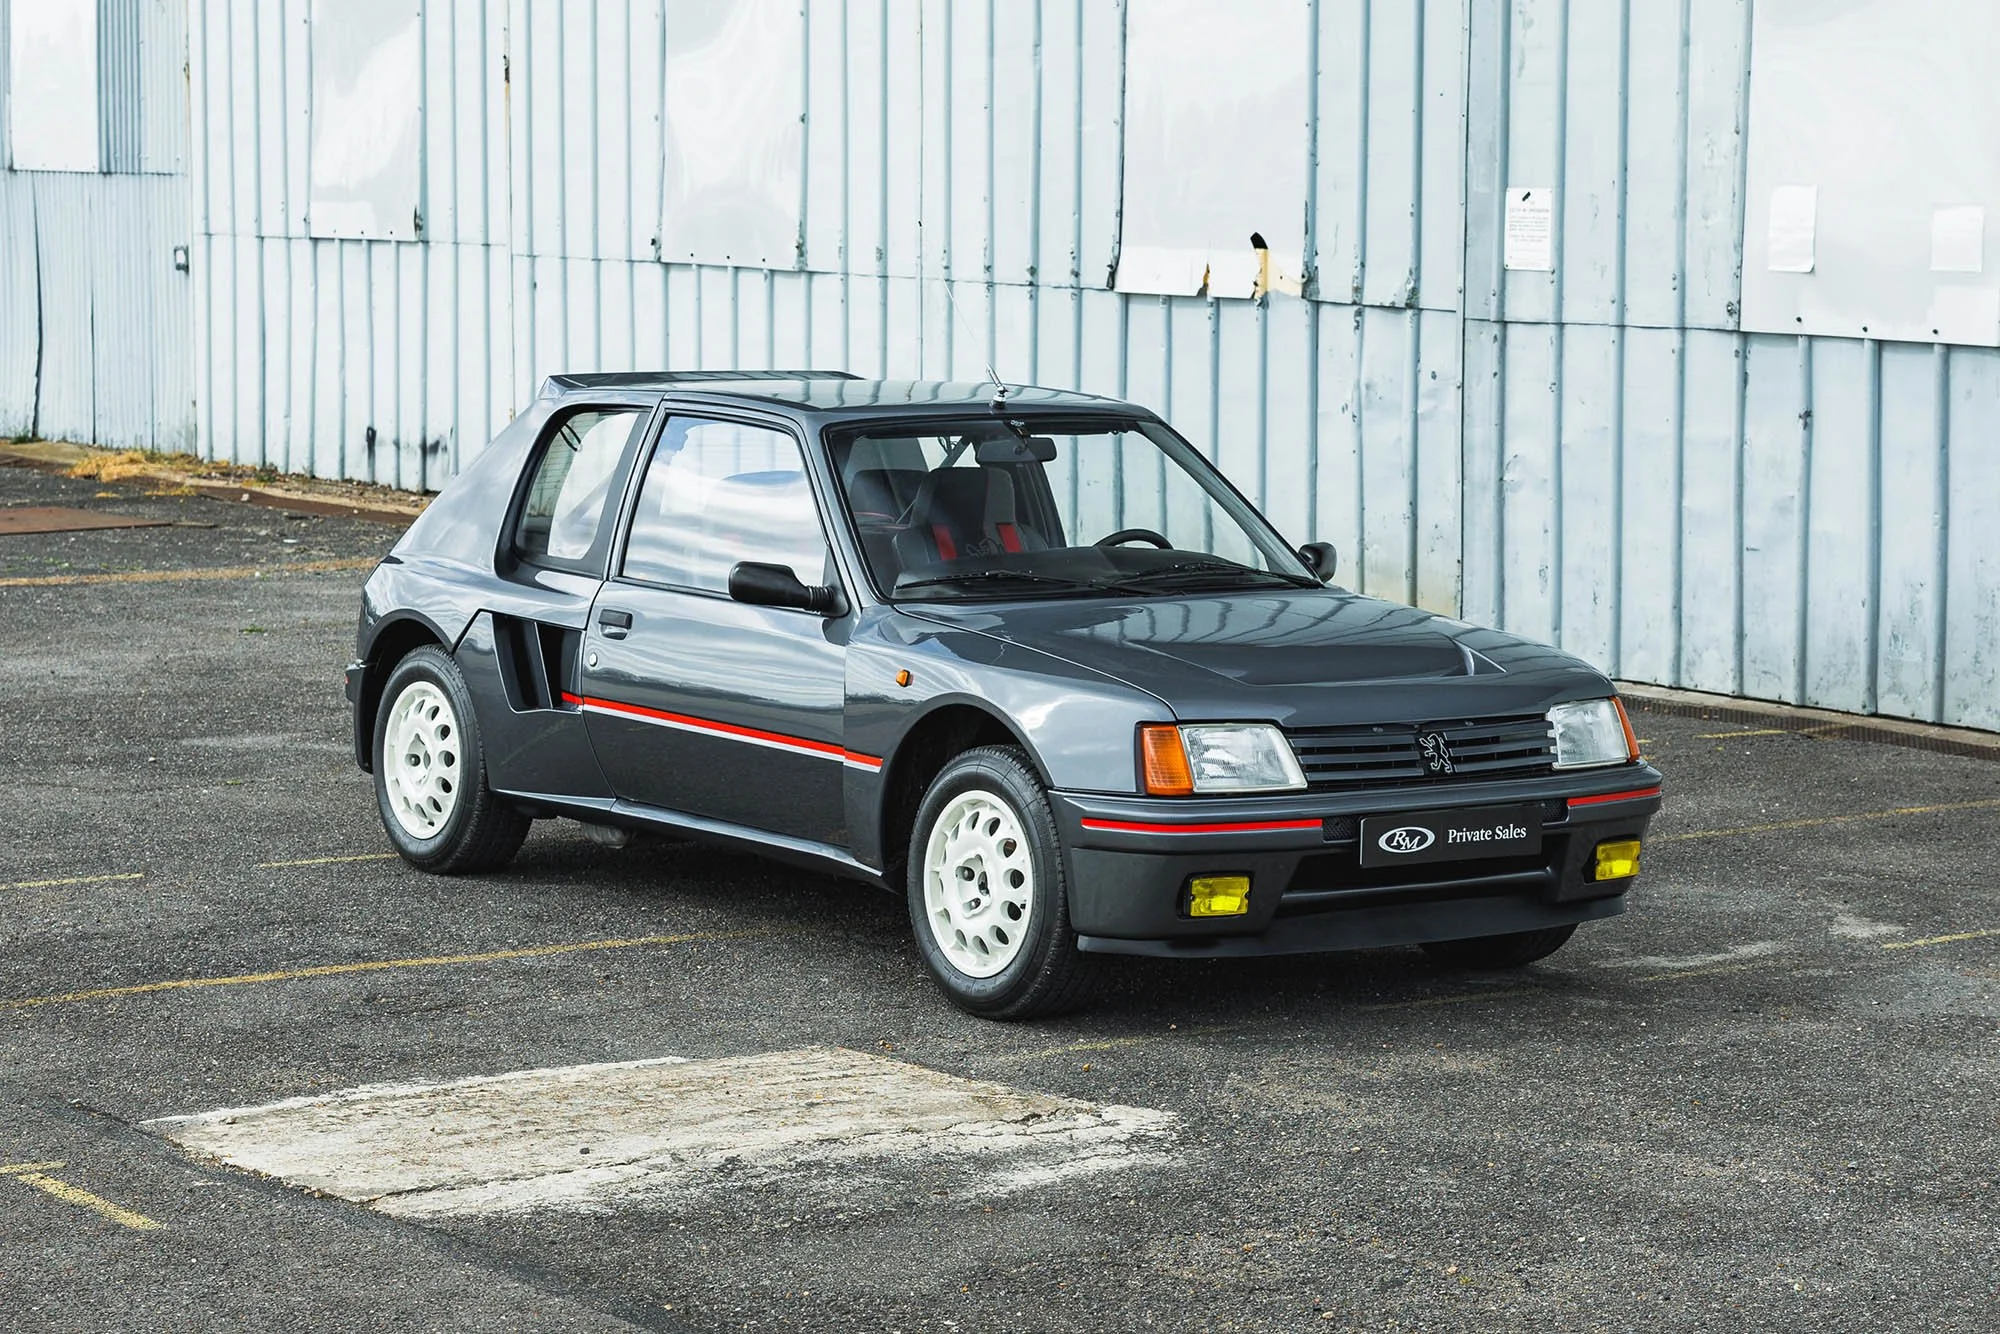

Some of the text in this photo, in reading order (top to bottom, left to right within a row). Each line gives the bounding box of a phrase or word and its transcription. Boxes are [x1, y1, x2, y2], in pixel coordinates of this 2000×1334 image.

[1390, 823, 1527, 850] RM Private Sales
